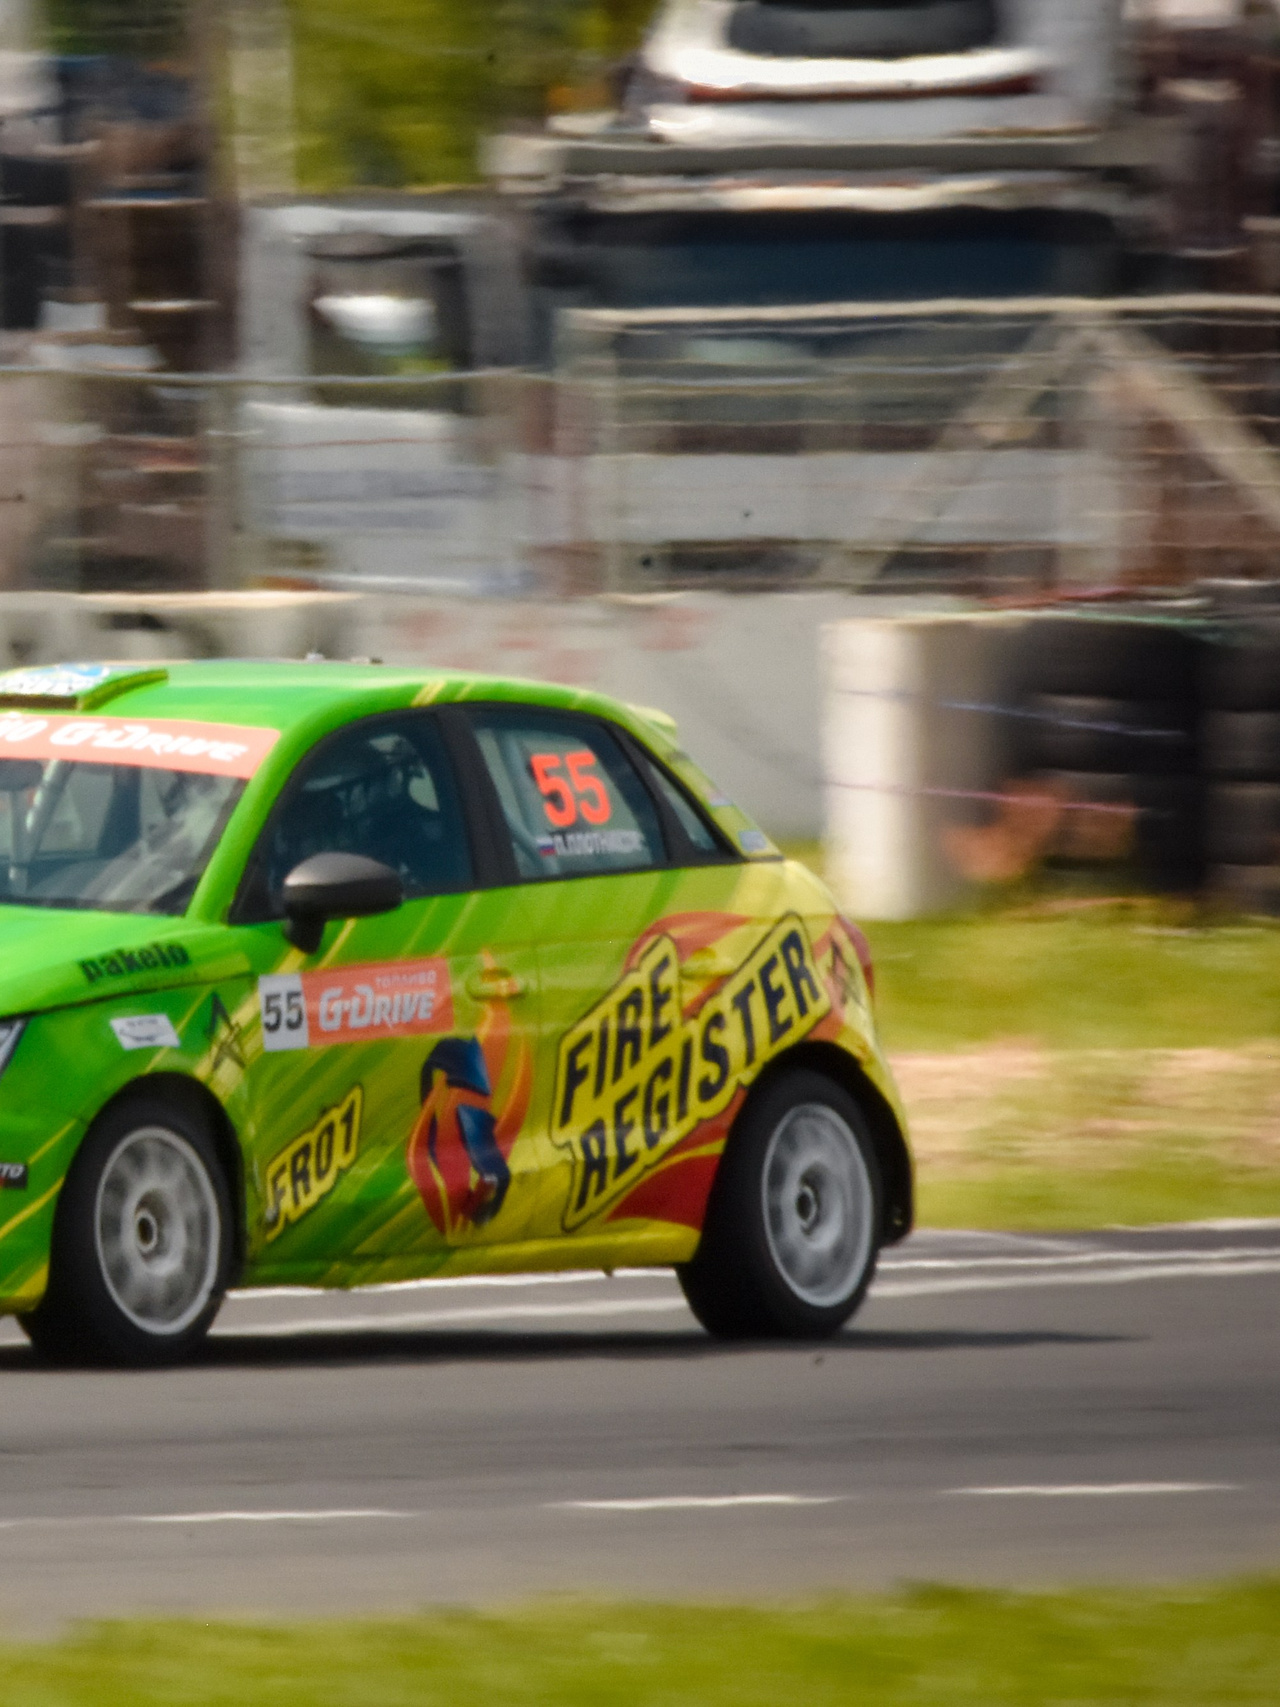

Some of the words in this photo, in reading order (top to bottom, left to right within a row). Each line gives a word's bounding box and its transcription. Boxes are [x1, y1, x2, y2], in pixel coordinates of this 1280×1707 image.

[530, 750, 612, 827] 55
[78, 941, 191, 983] pakelo
[262, 989, 306, 1034] 55
[559, 955, 672, 1128] FIRE
[574, 929, 820, 1212] REGISTER
[267, 1099, 356, 1229] FR01
